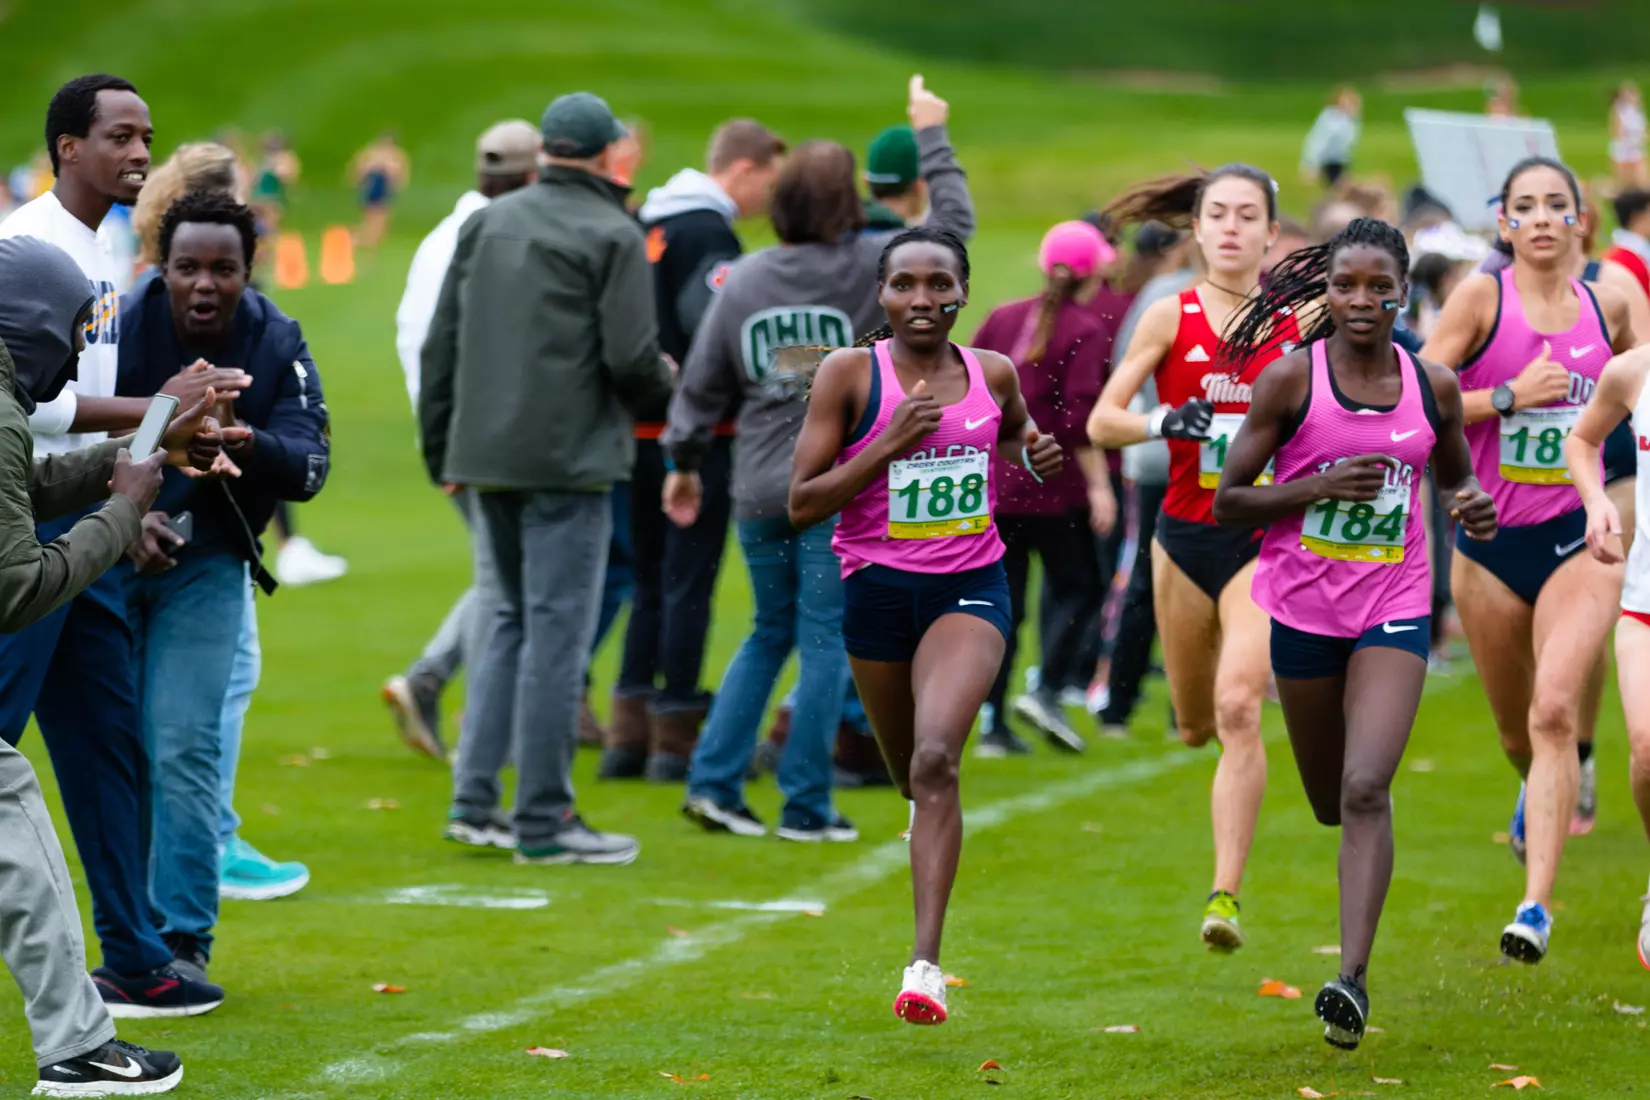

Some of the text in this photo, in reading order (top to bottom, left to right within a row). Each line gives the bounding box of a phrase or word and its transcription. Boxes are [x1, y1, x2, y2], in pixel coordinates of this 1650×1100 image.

[744, 306, 852, 381] OHIO
[1508, 426, 1572, 465] 18
[898, 473, 983, 519] 188
[1315, 499, 1404, 542] 184
